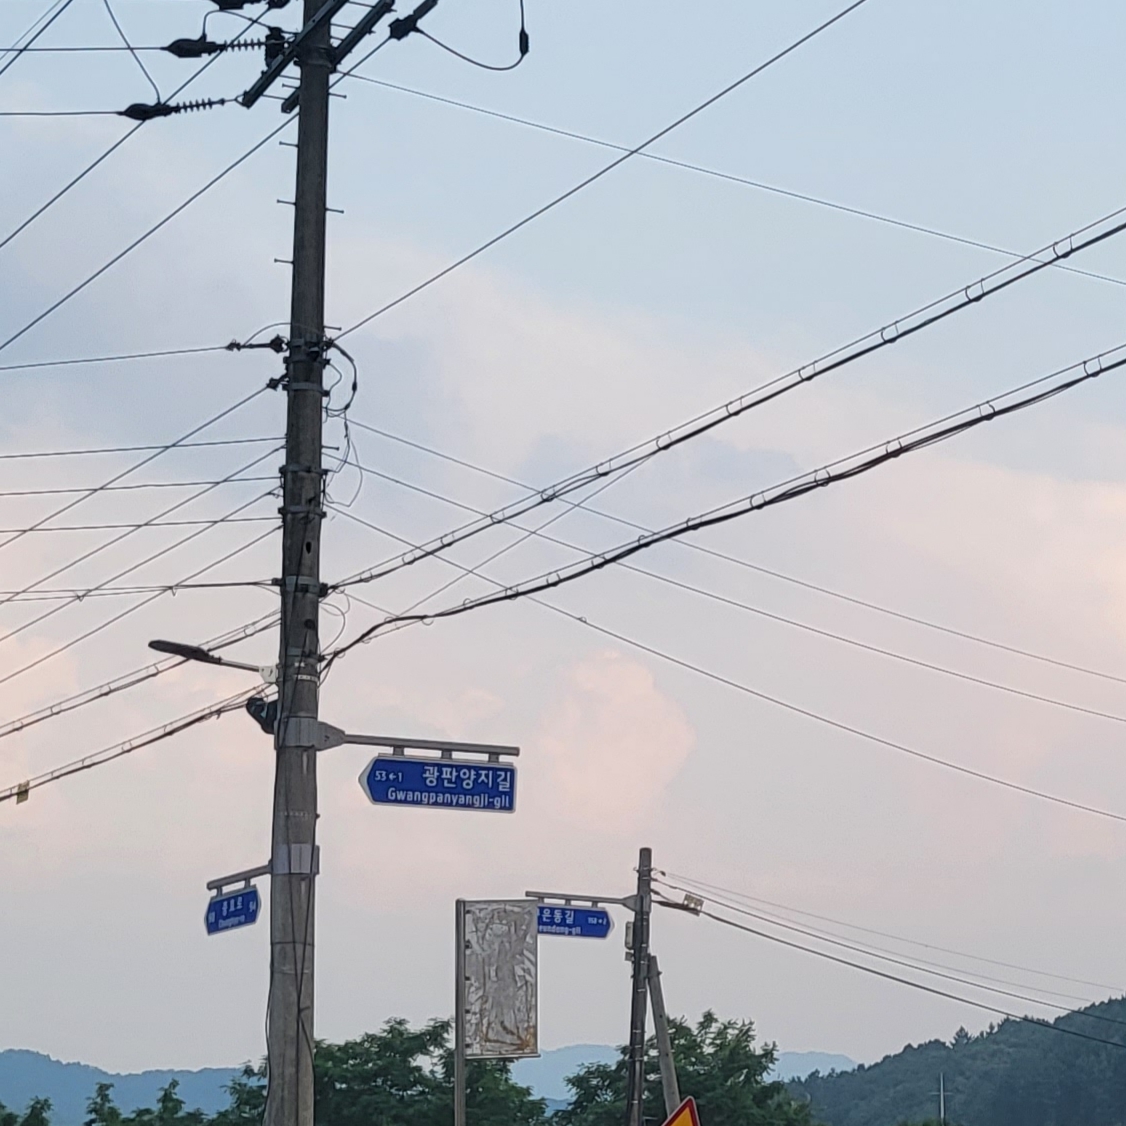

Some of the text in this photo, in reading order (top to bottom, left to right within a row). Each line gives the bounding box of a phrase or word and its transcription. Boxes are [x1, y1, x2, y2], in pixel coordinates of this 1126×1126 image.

[422, 765, 511, 791] 광판양지길
[387, 787, 510, 808] Gwangpanyangji-gil
[537, 908, 574, 924] 은동길
